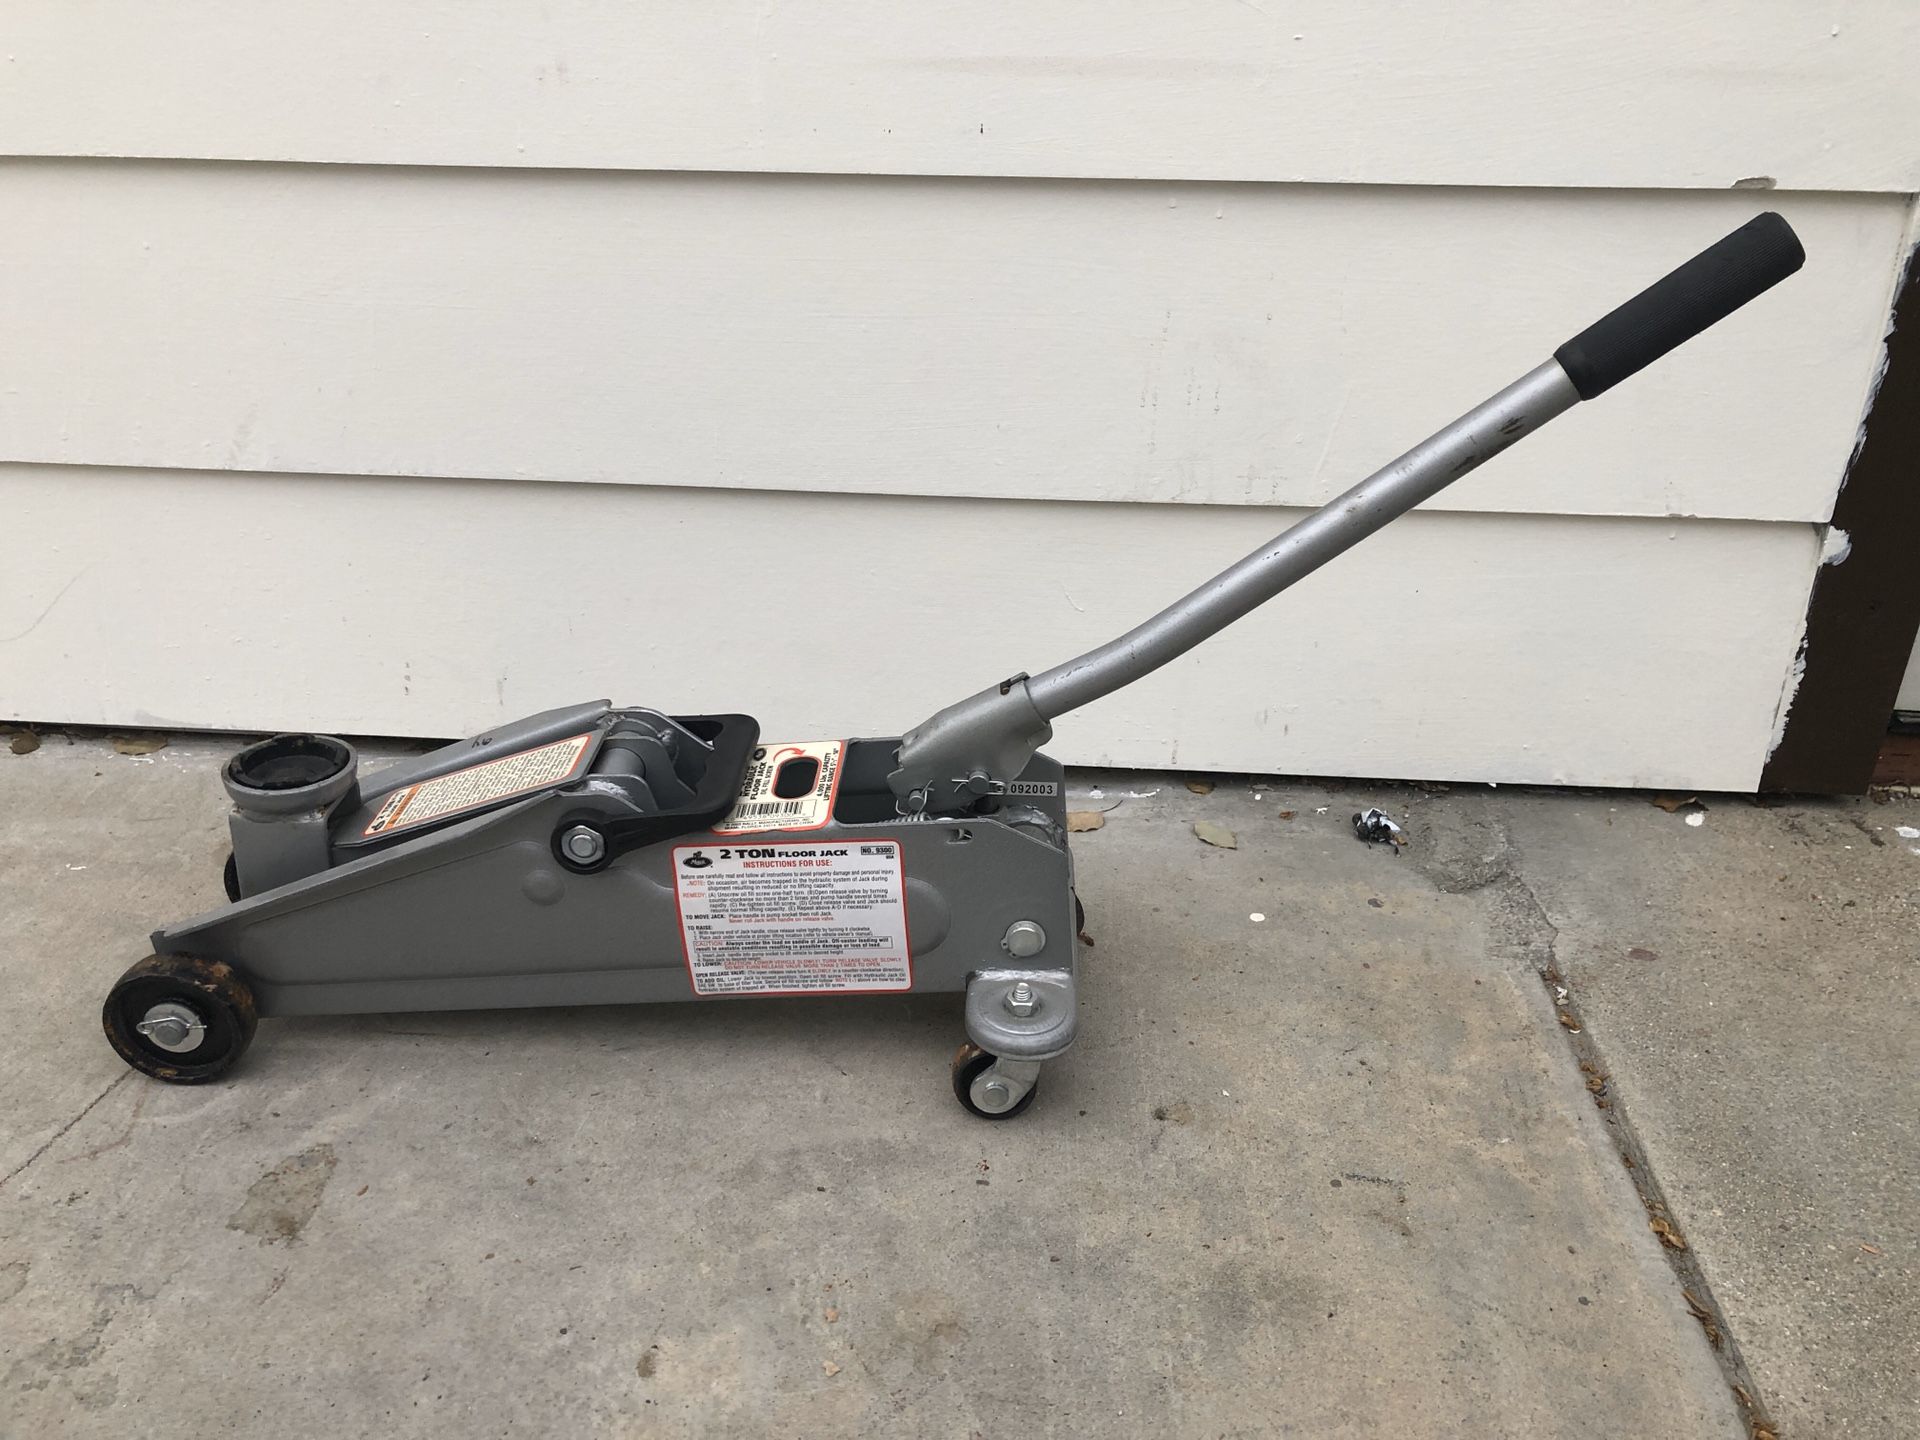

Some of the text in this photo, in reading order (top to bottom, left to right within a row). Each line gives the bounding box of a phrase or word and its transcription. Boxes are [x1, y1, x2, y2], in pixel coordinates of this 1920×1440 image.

[750, 762, 767, 800] FLOOR JACK
[1010, 784, 1053, 794] 092003
[720, 849, 731, 859] 2
[735, 848, 775, 858] TON
